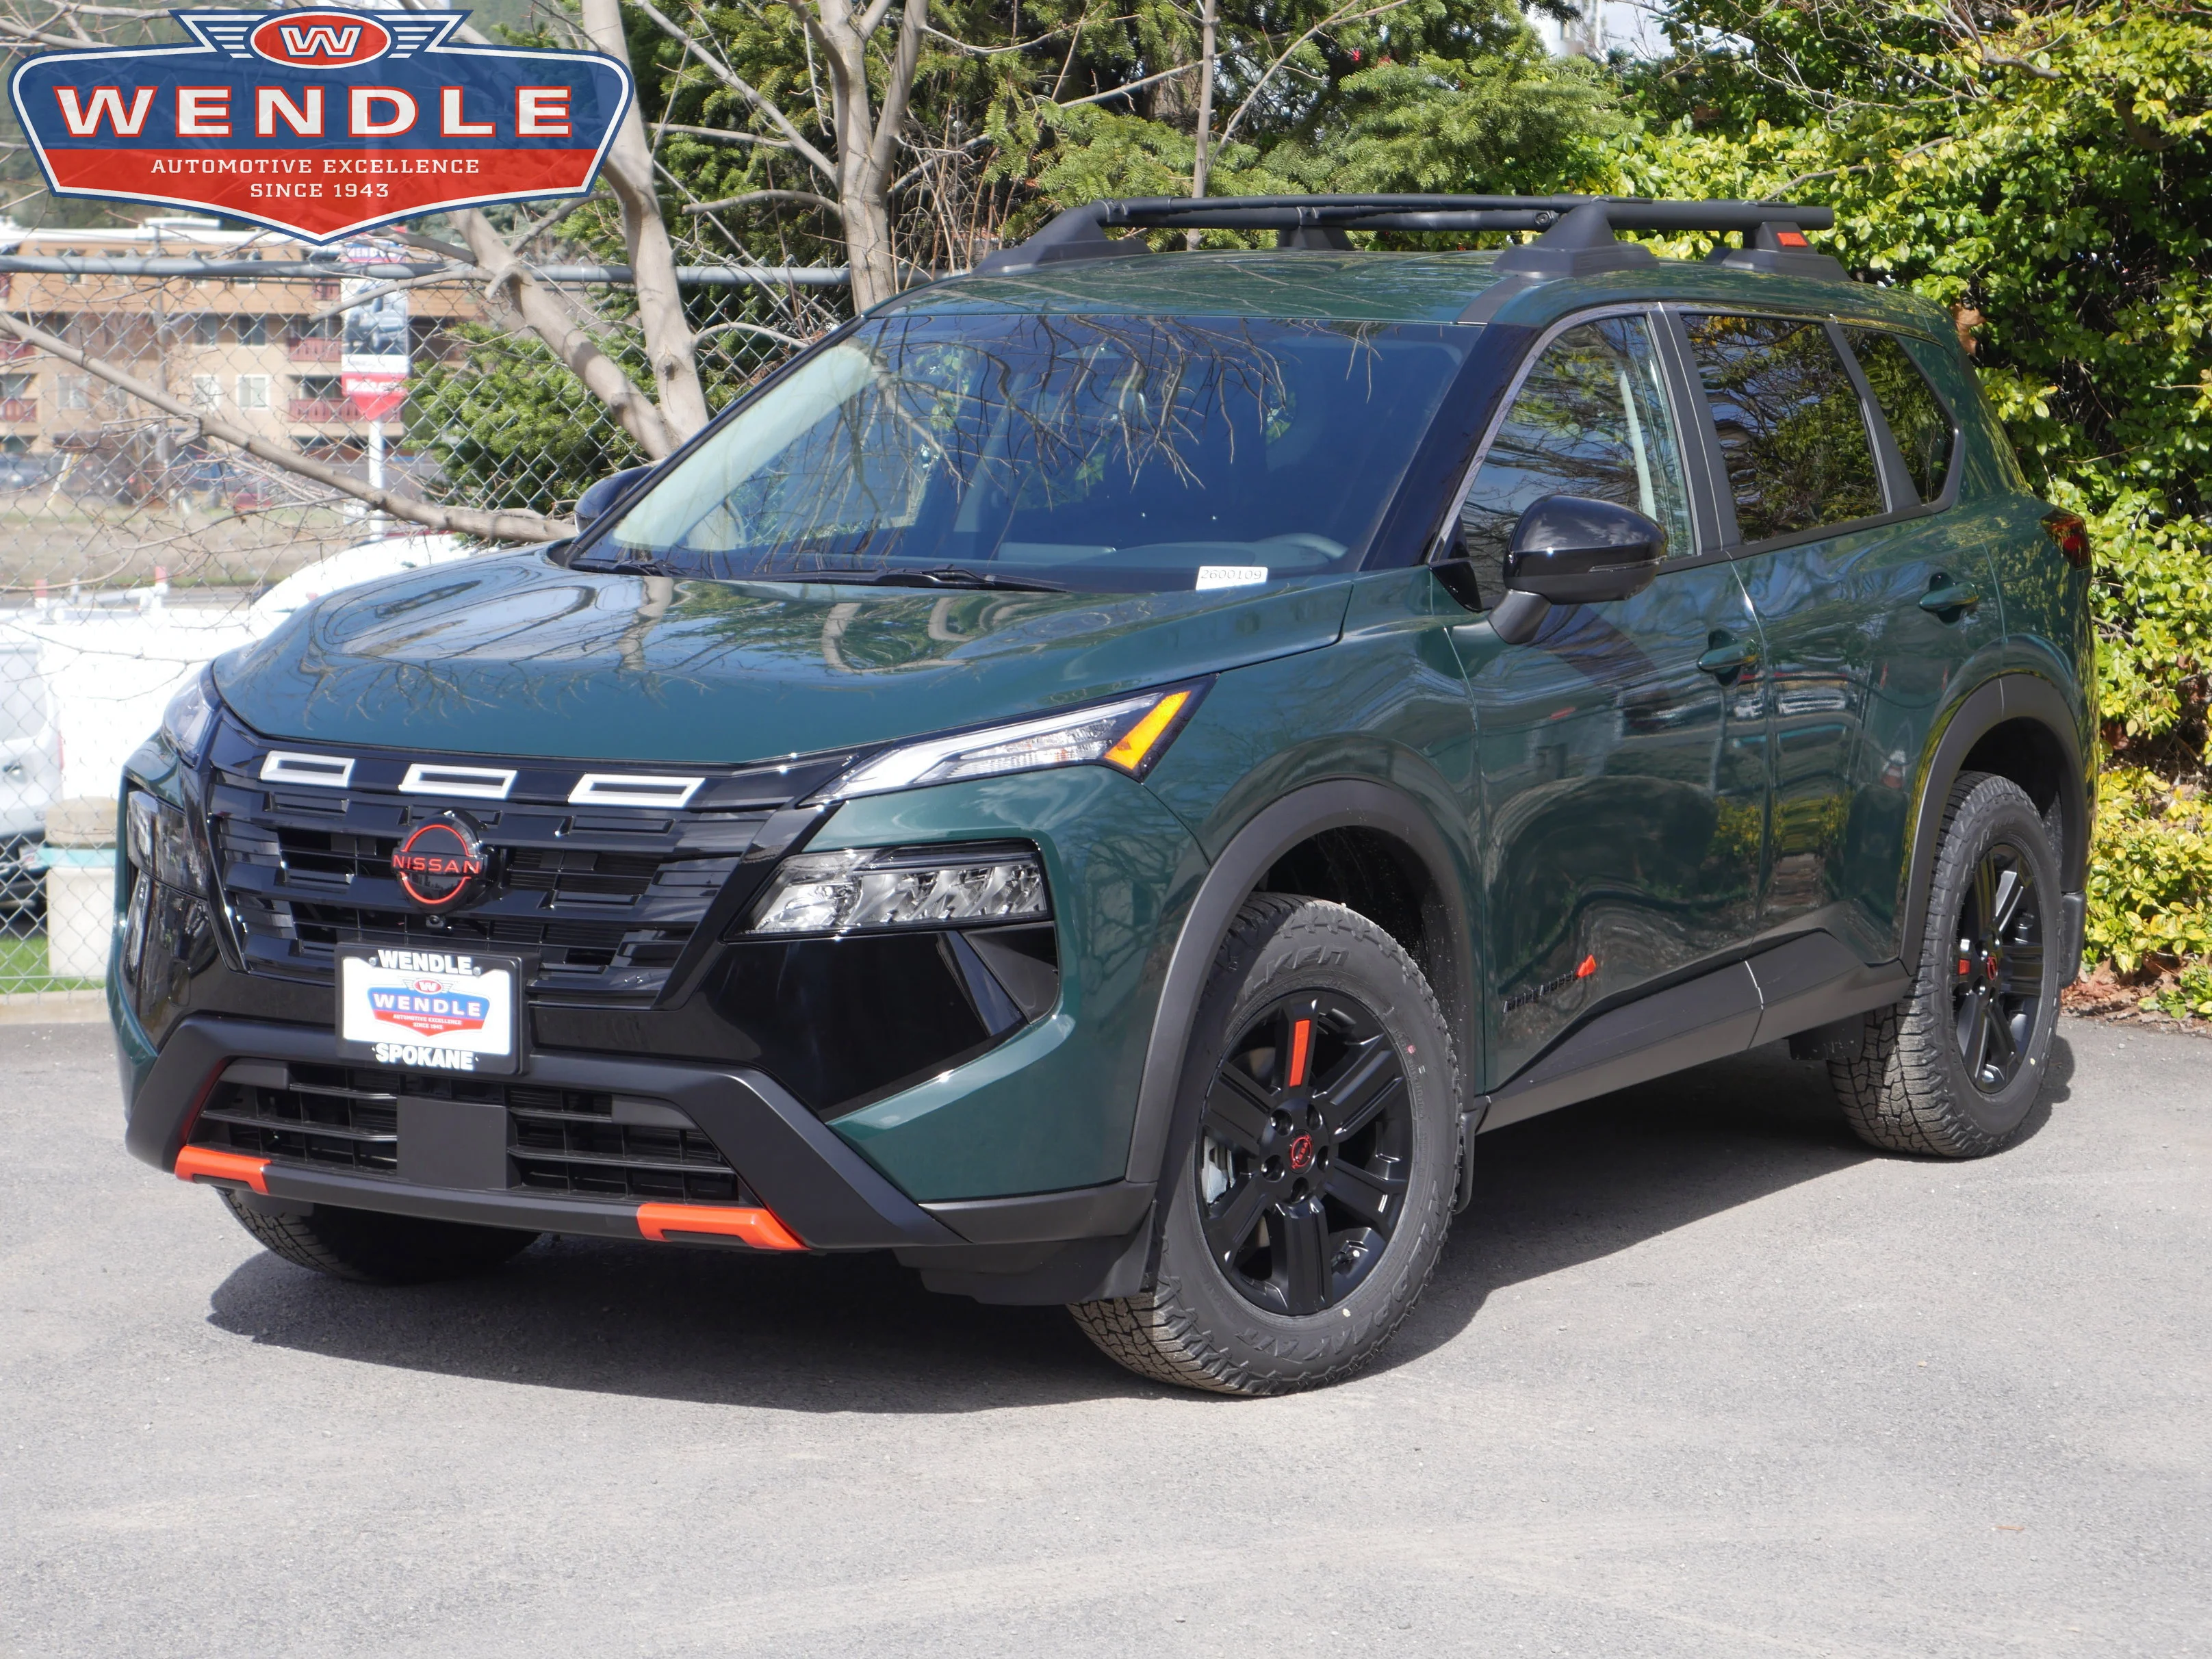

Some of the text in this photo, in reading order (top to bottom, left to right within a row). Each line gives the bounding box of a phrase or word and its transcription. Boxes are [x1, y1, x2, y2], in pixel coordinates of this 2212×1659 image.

[1200, 569, 1262, 580] 2600109
[393, 855, 480, 874] NISSAN
[377, 949, 473, 975] WENDLE
[372, 992, 481, 1017] WENDLE
[392, 1014, 428, 1023] AUTOMOTIVE
[375, 1042, 474, 1071] SPOKANE
